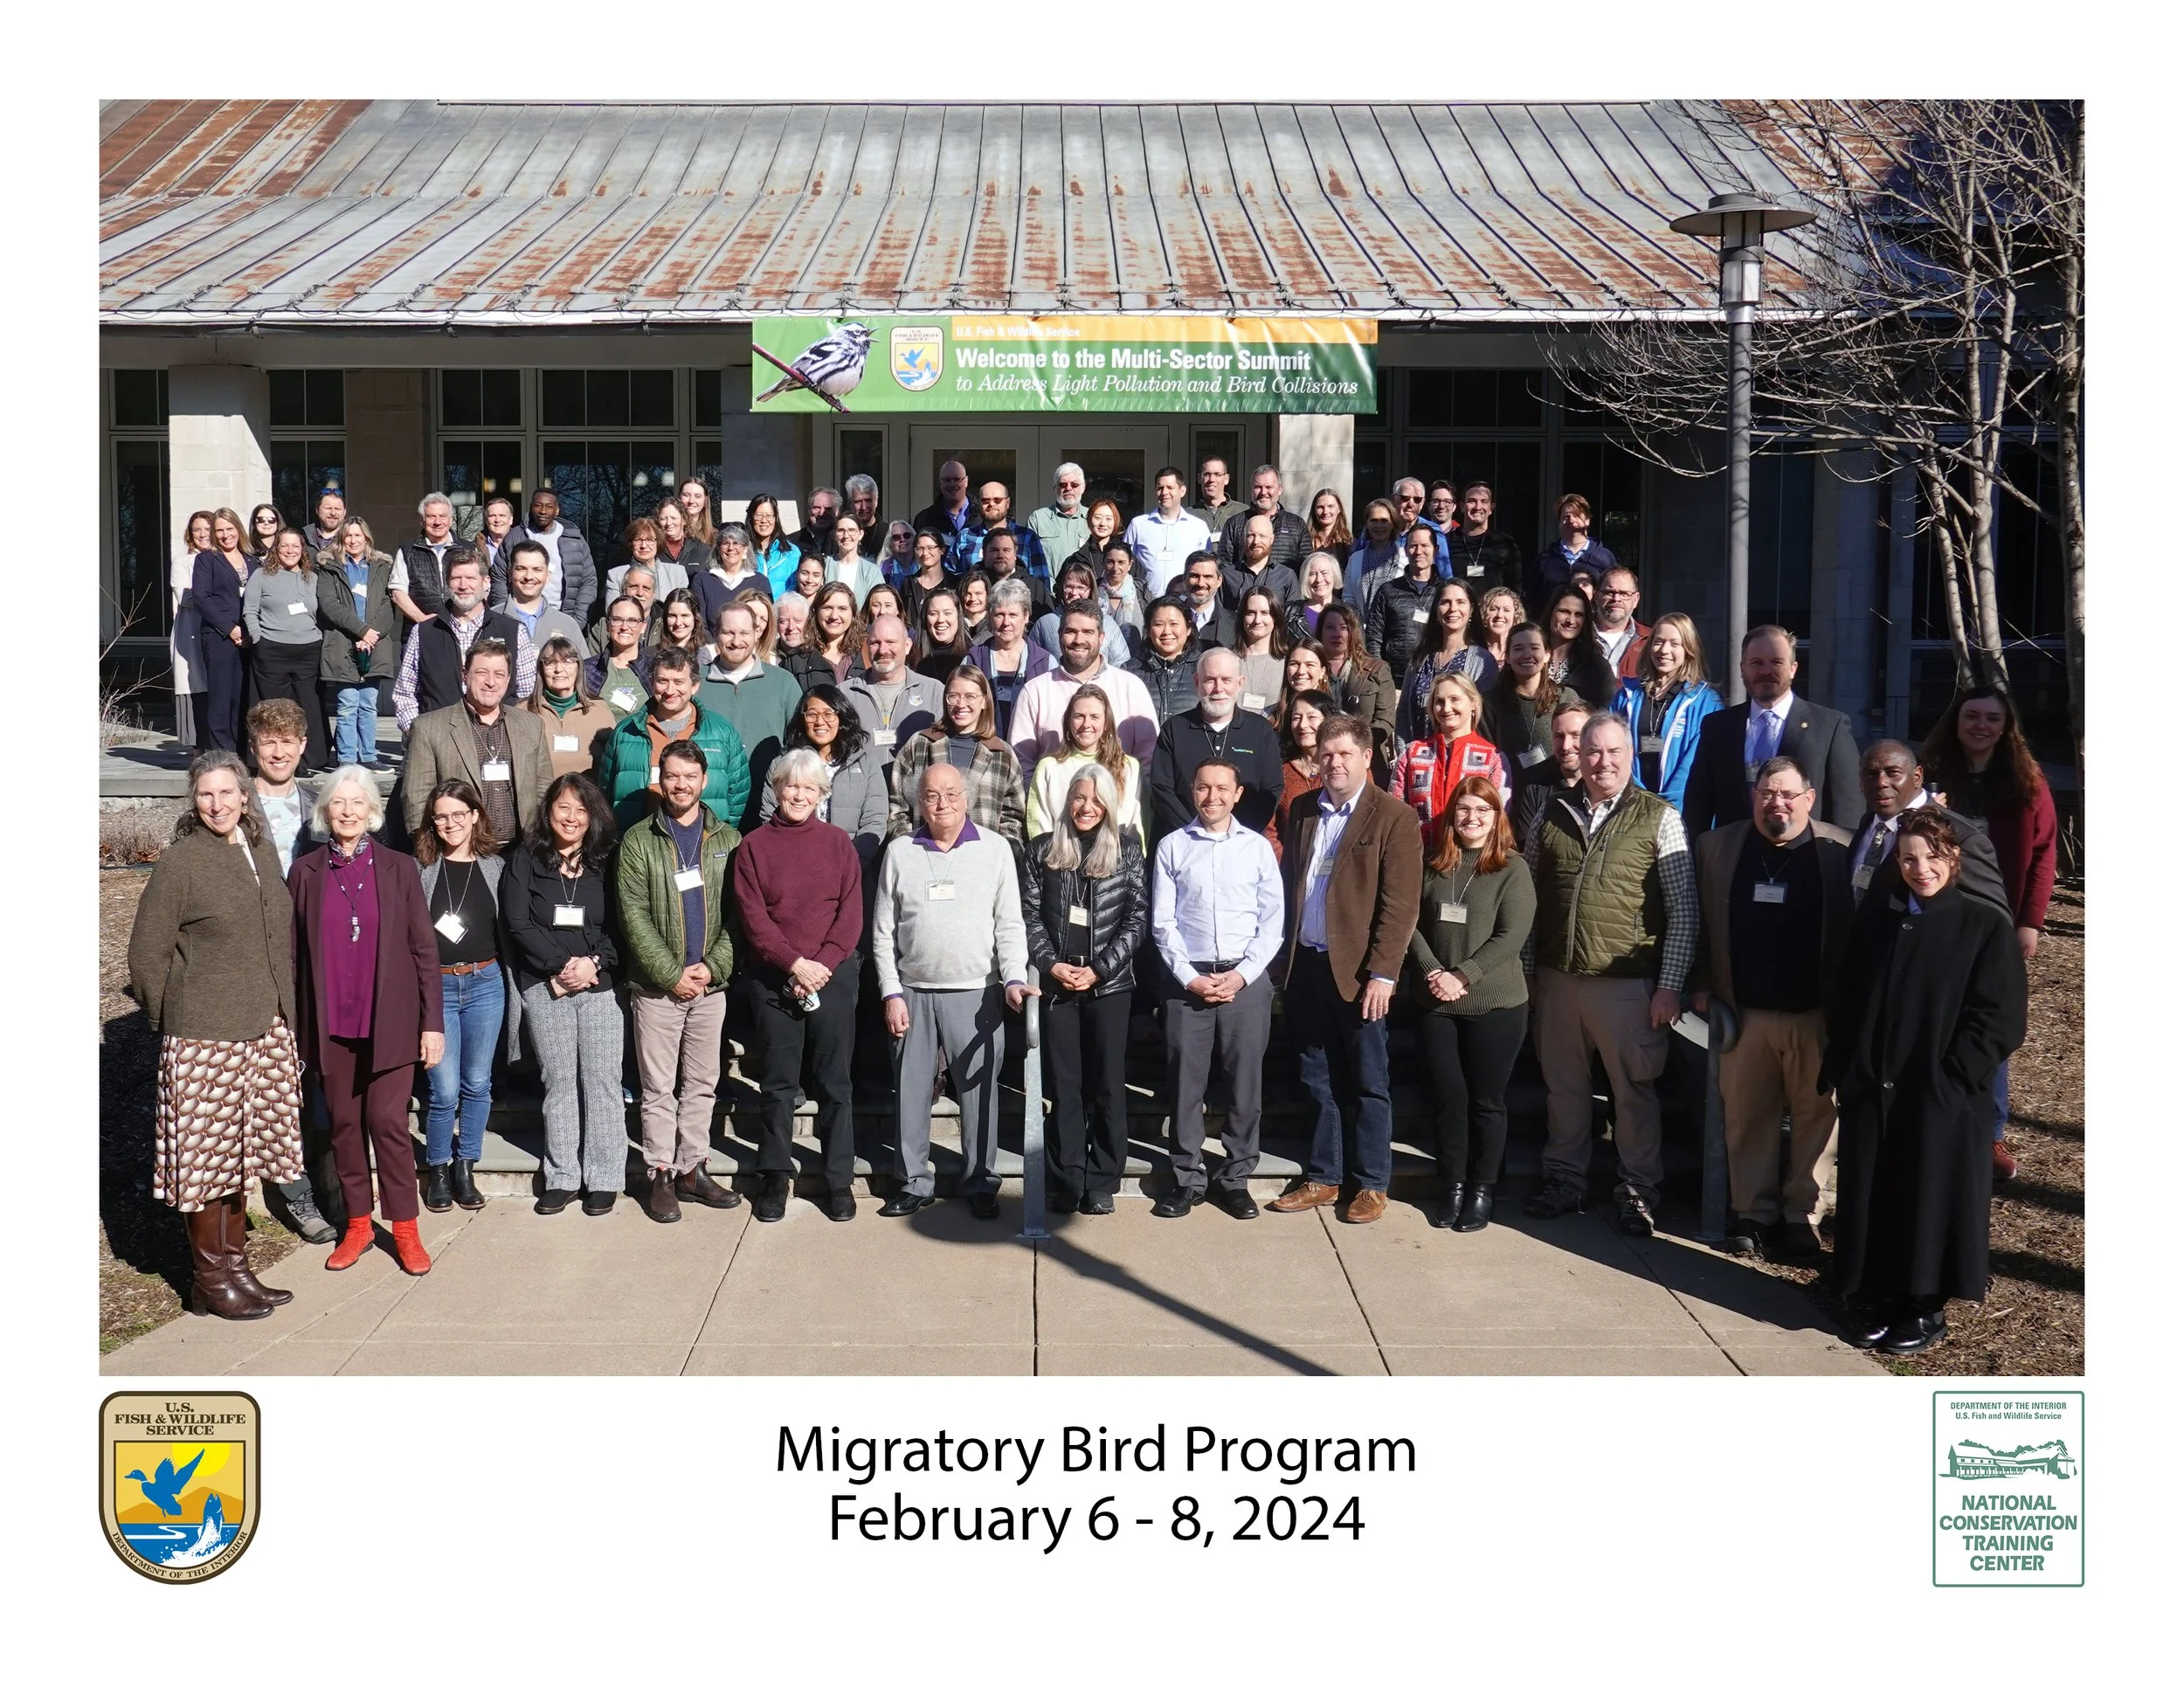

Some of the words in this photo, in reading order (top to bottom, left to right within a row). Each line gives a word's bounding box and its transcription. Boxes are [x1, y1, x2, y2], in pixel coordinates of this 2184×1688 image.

[956, 326, 974, 337] U.S.
[976, 326, 995, 337] Fish
[997, 326, 1006, 337] &
[1007, 325, 1042, 337] Wildli
[1045, 327, 1080, 337] Service
[955, 348, 1047, 369] Welcome
[1052, 350, 1071, 369] to
[1075, 349, 1106, 369] the
[1111, 348, 1234, 370] Multi-Sector
[1237, 349, 1311, 370] Summit
[956, 377, 972, 391] to
[977, 373, 1047, 391] Address
[1052, 374, 1098, 396] Light
[1102, 375, 1184, 392] Pollution
[1187, 376, 1223, 393] and
[1227, 376, 1266, 393] Bird
[1271, 376, 1358, 394] Collisions
